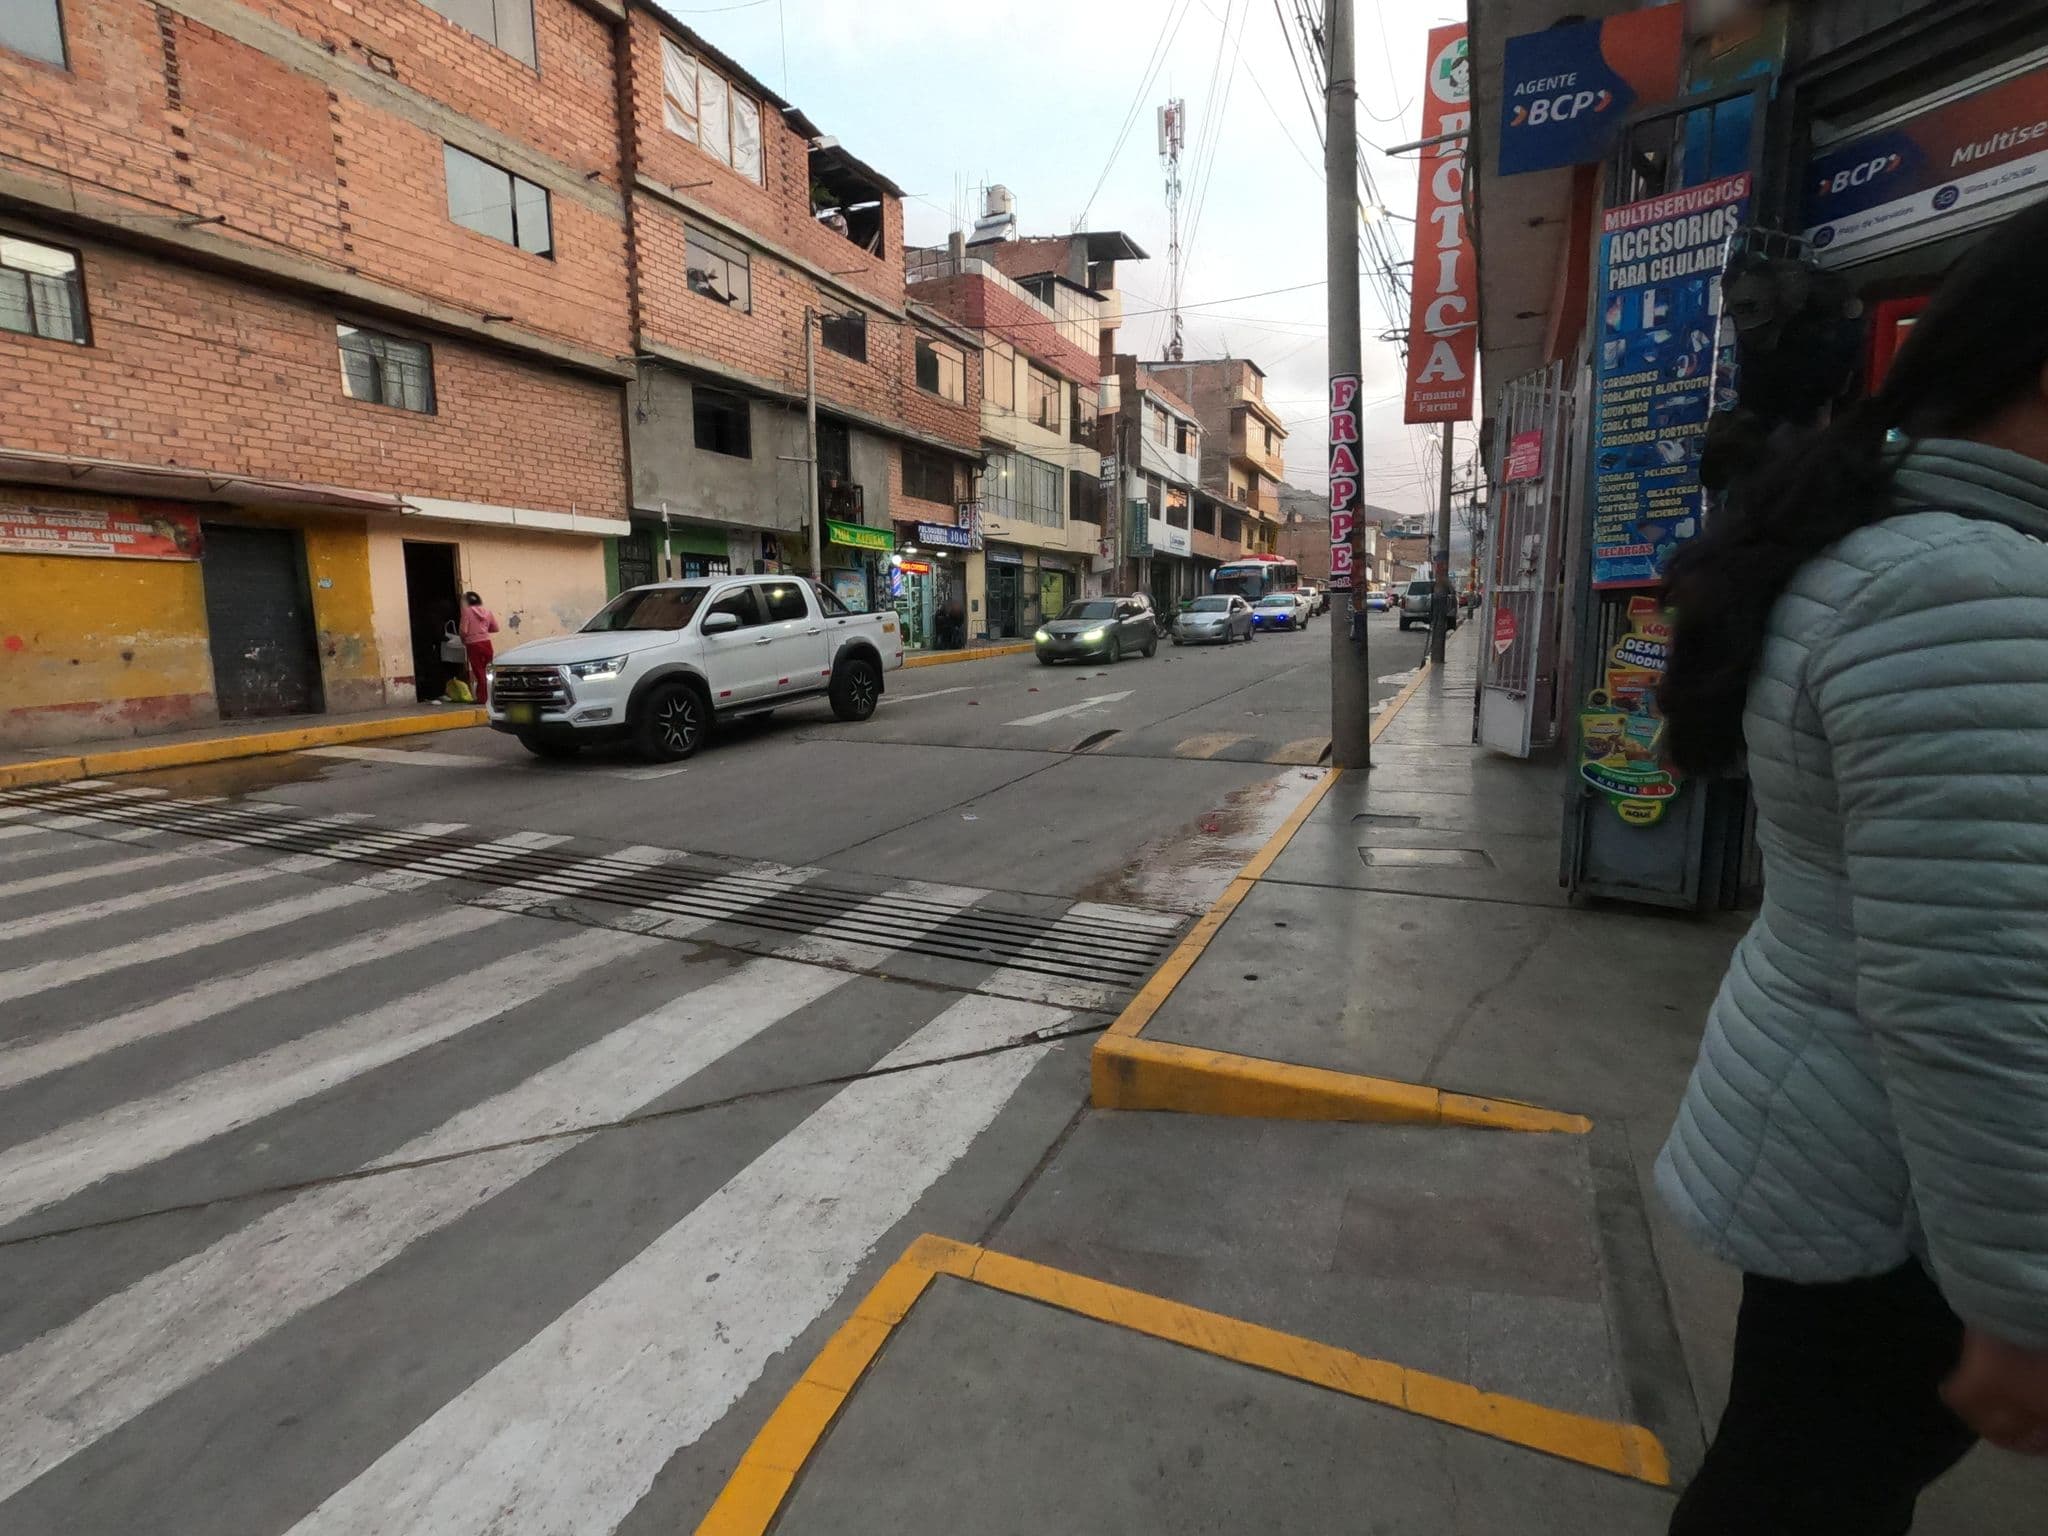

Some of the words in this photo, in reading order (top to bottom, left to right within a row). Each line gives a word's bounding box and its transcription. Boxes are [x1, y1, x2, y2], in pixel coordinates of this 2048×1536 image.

[1513, 72, 1577, 96] AGENTE
[1527, 91, 1594, 125] BCP
[1831, 157, 1888, 194] BCP
[1605, 177, 1746, 231] MULTISERVICIOS
[1609, 203, 1738, 265] ACCESORIOS
[1609, 262, 1648, 291] PARA
[1330, 377, 1359, 575] FRAPPE
